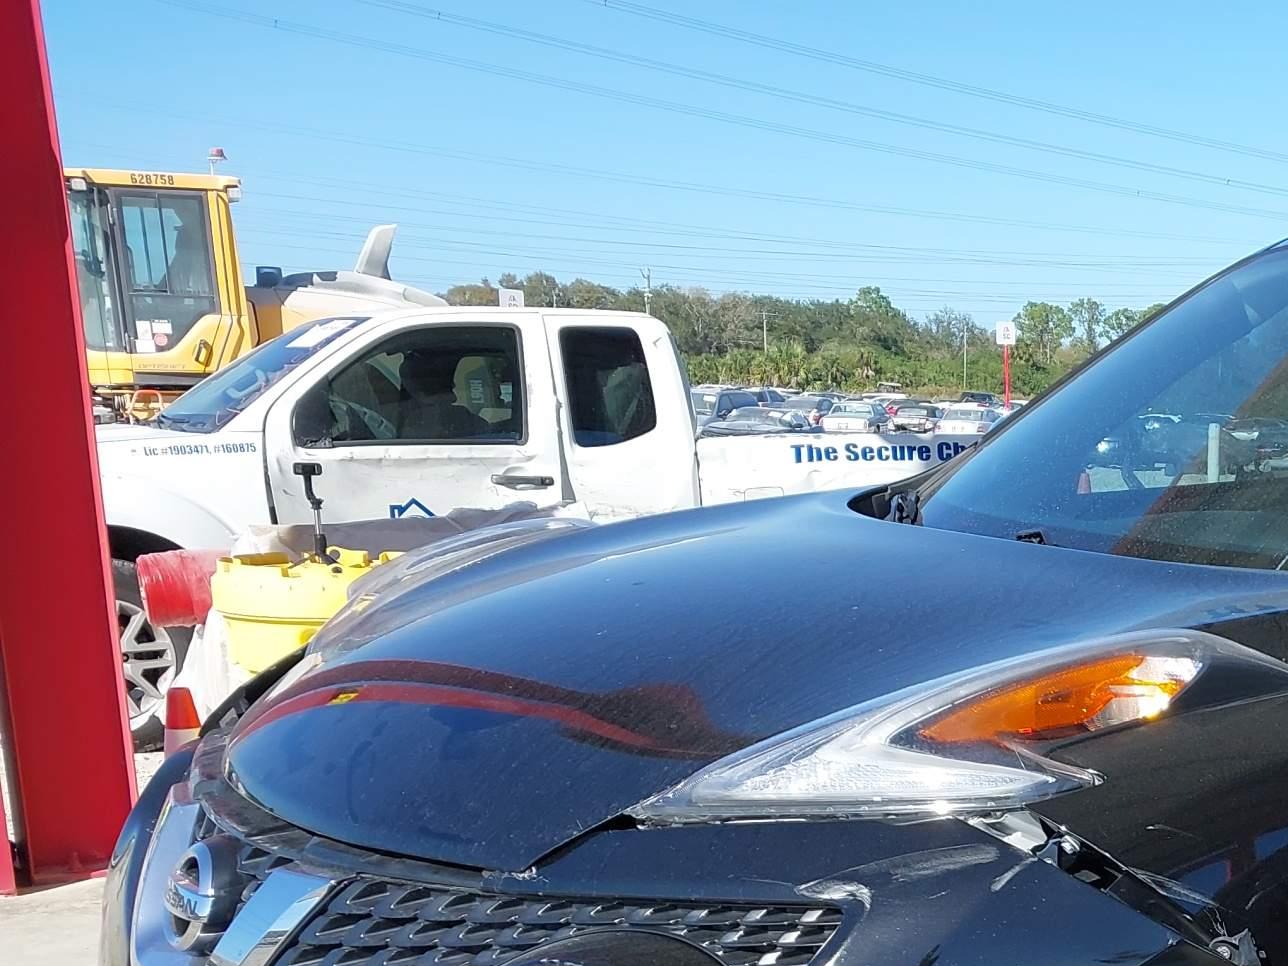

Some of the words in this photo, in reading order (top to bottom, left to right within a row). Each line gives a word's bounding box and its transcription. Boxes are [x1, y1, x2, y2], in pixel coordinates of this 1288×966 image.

[130, 173, 175, 186] 628758
[790, 444, 838, 463] The
[844, 443, 931, 461] Secure
